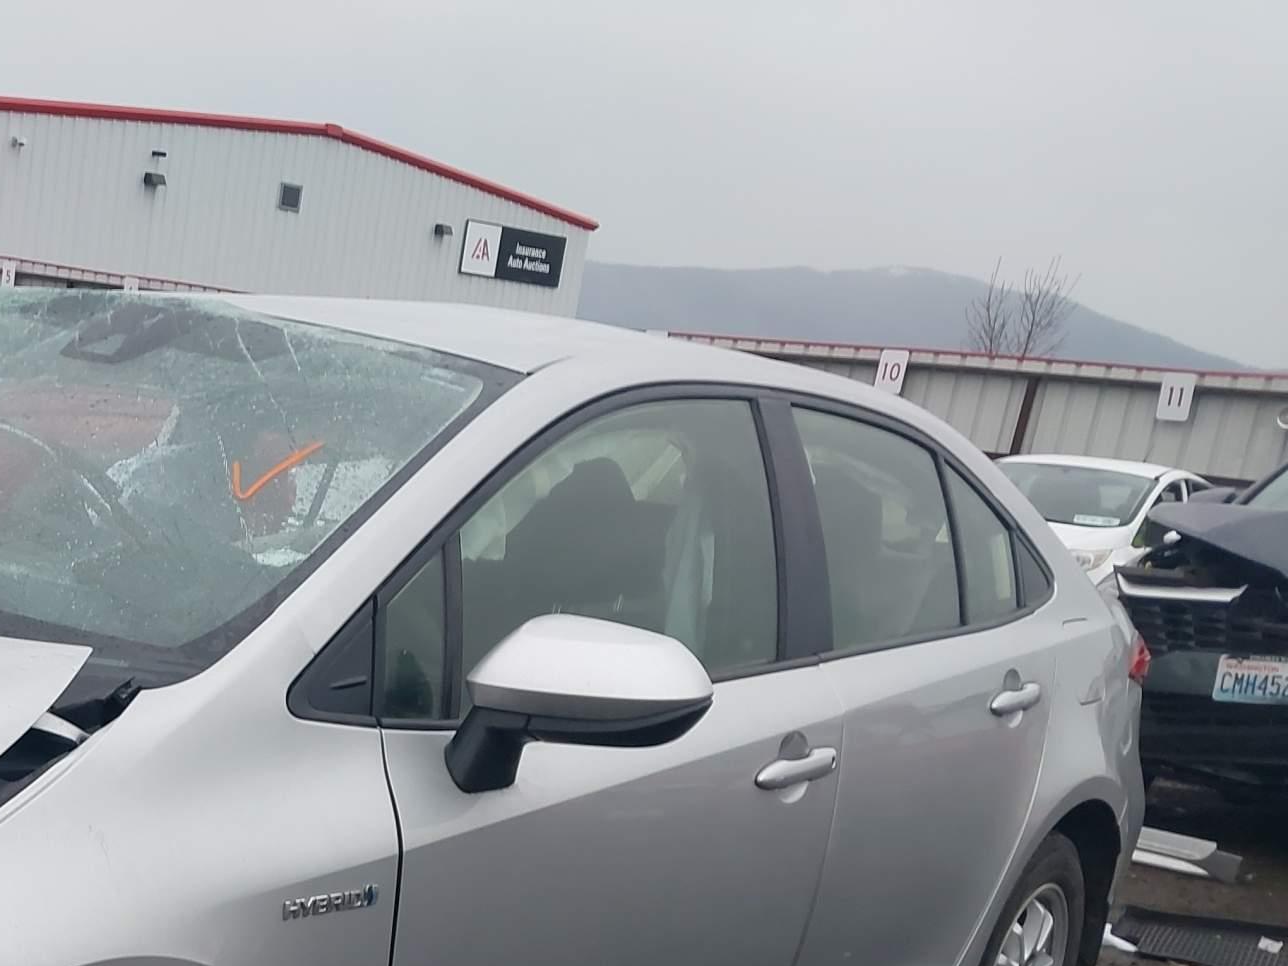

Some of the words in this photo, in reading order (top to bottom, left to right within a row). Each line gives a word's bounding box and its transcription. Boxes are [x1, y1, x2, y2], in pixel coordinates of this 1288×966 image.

[515, 242, 546, 259] Insurance
[507, 255, 523, 269] Auto
[523, 258, 550, 274] Auctions
[881, 362, 901, 381] 10
[1167, 385, 1185, 407] 11
[282, 889, 362, 921] HYBRID
